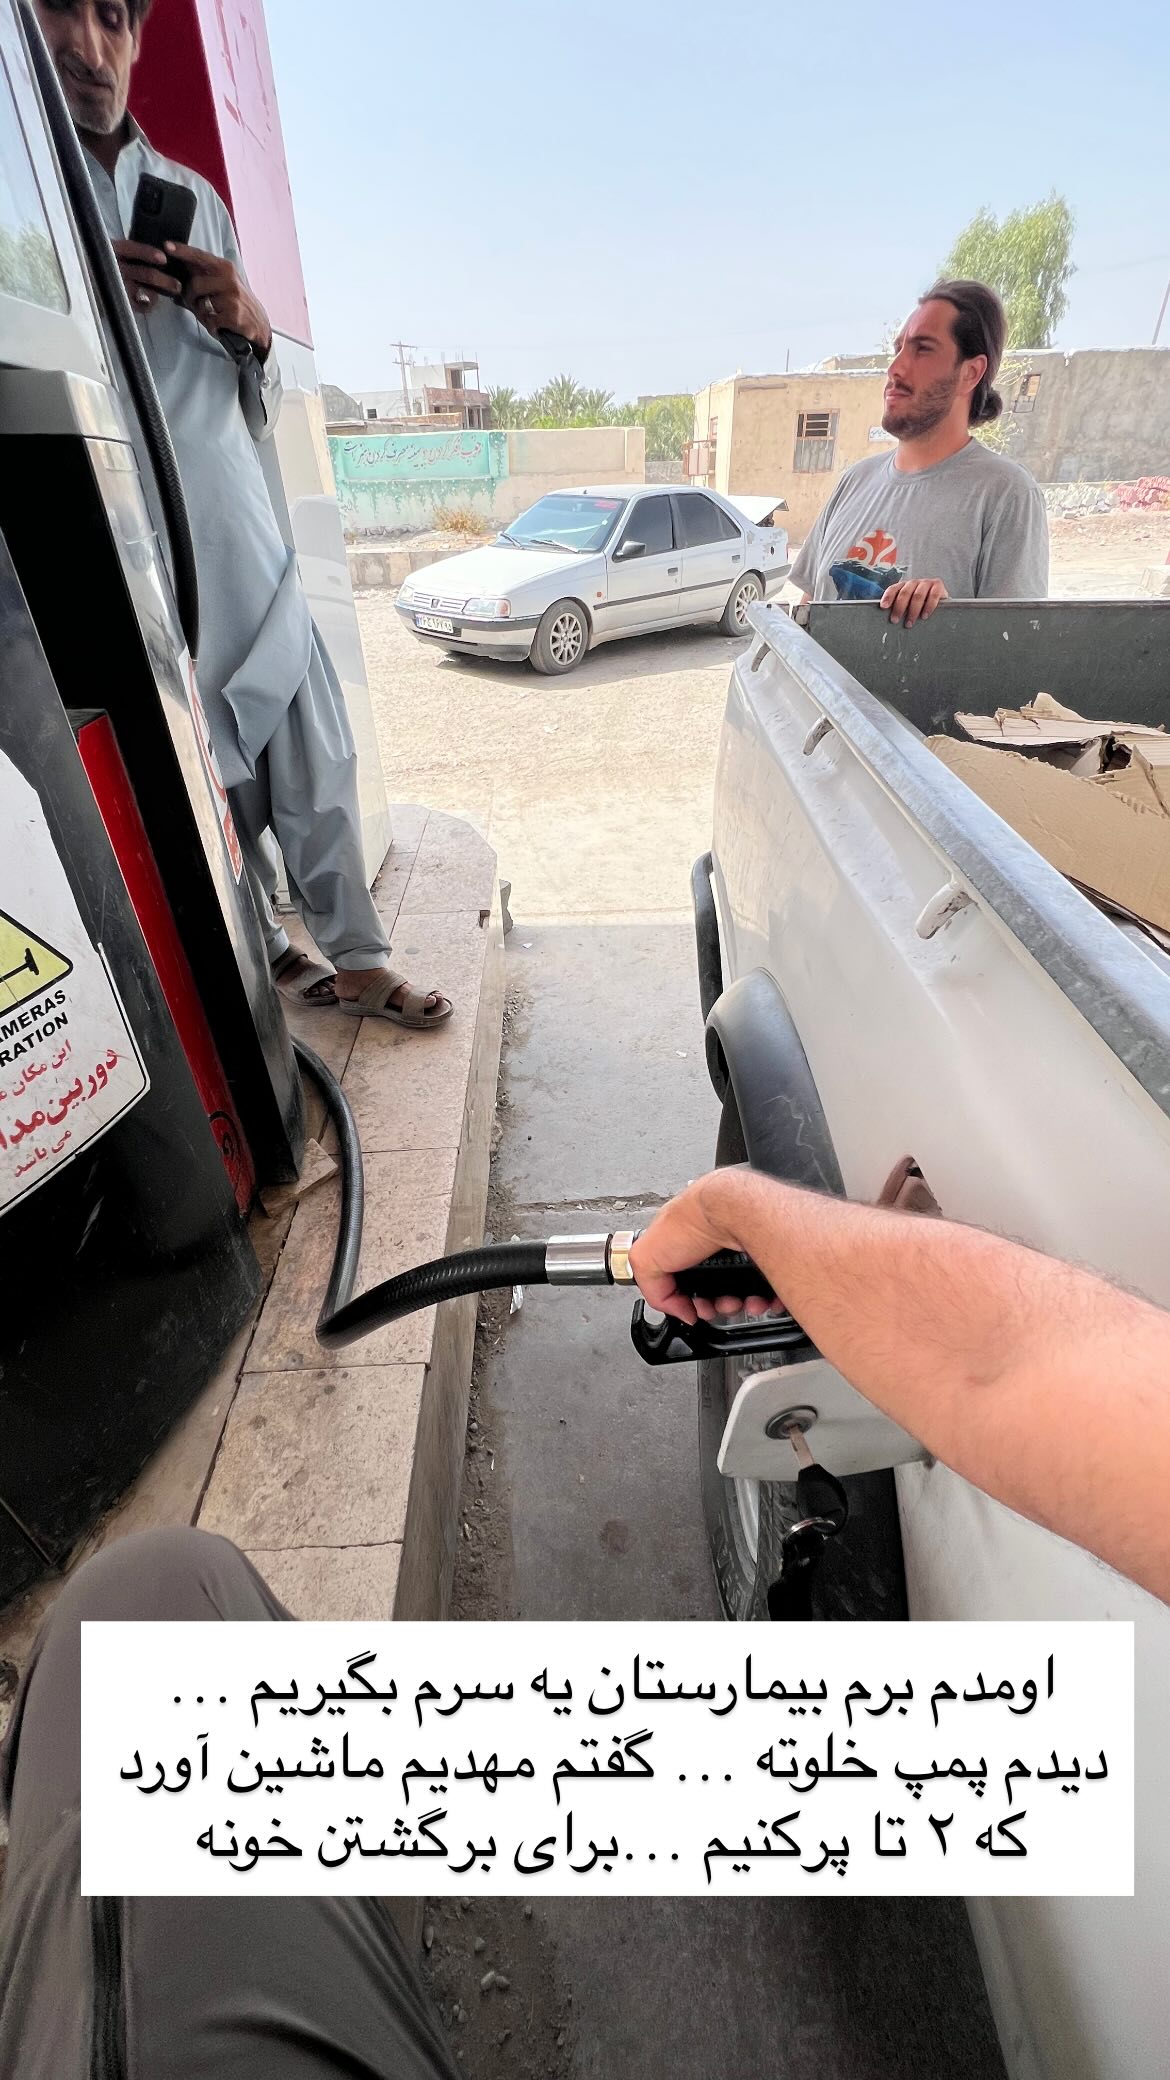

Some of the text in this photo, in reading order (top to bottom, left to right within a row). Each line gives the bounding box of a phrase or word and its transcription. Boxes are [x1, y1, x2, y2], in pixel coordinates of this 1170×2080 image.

[13, 1039, 71, 1096] این مکان
[46, 1048, 119, 1126] دوربین
[52, 1130, 71, 1153] می
